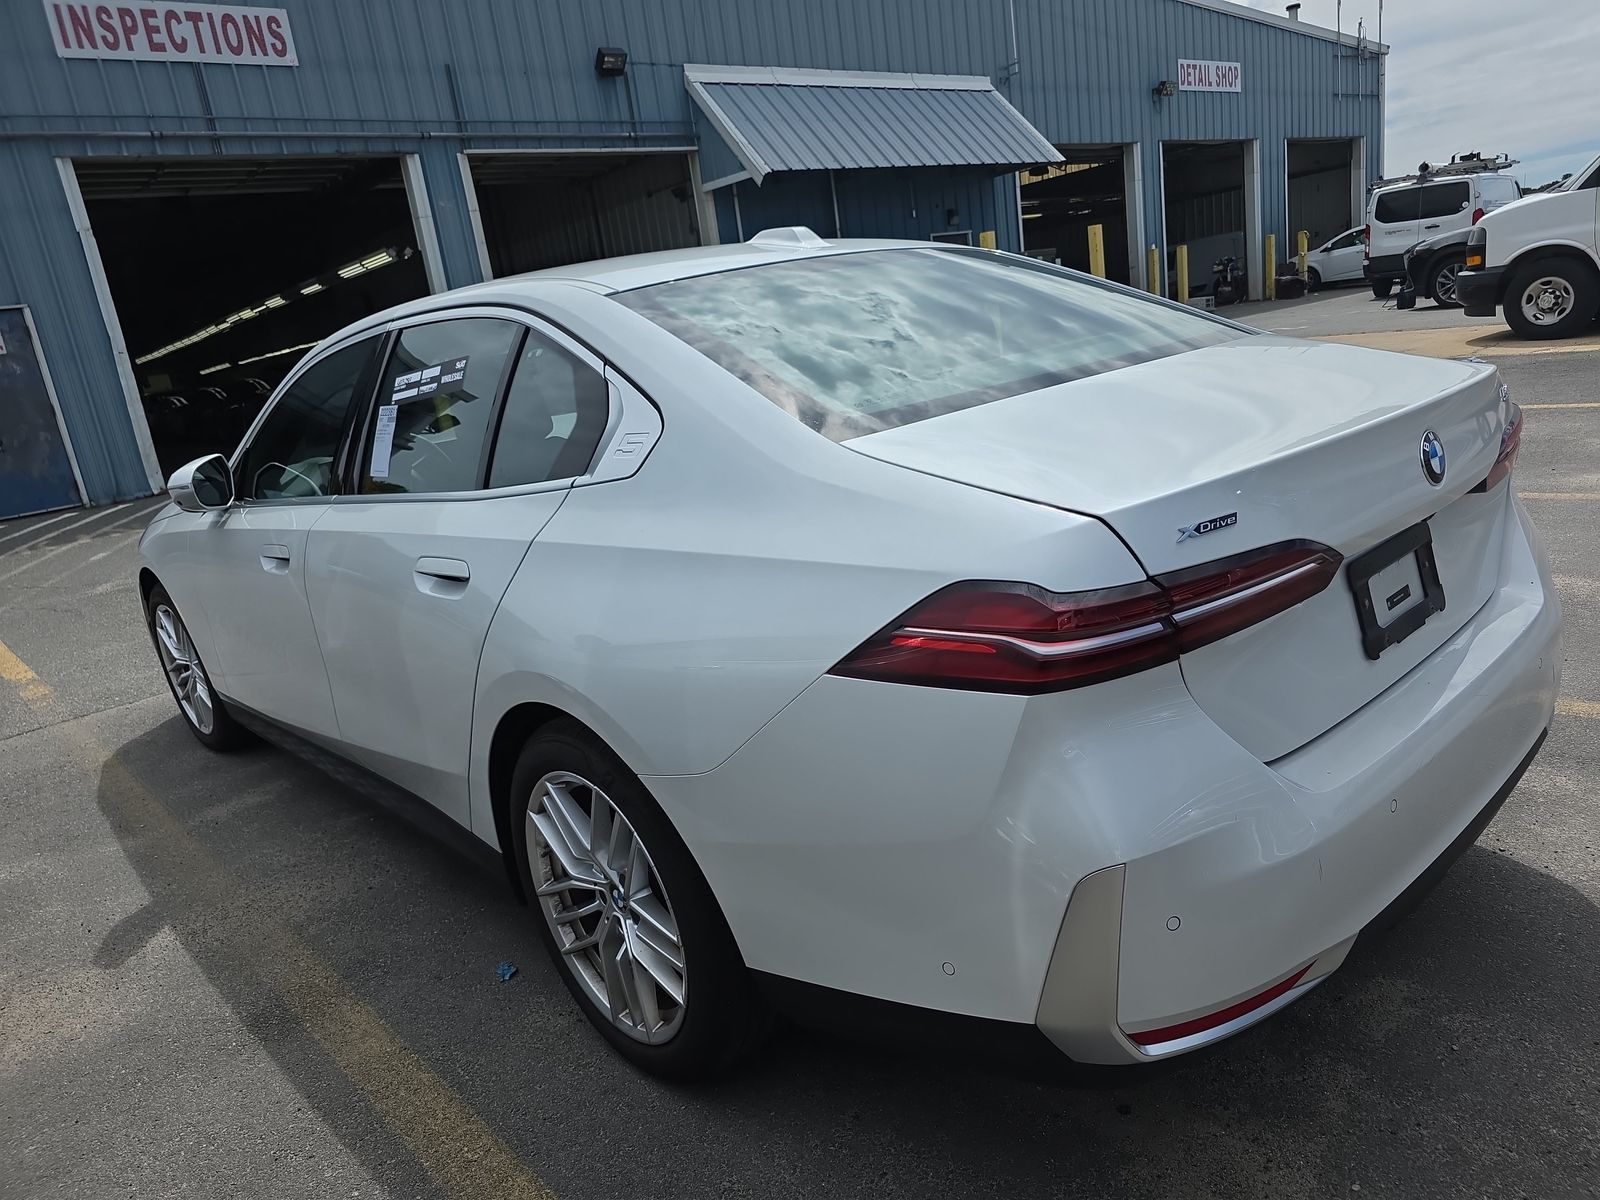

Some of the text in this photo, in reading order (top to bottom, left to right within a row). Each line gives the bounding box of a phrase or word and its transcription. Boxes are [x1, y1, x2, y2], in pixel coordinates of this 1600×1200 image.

[53, 3, 288, 58] INSPECTIONS
[1180, 63, 1239, 88] DETAIL SHOP
